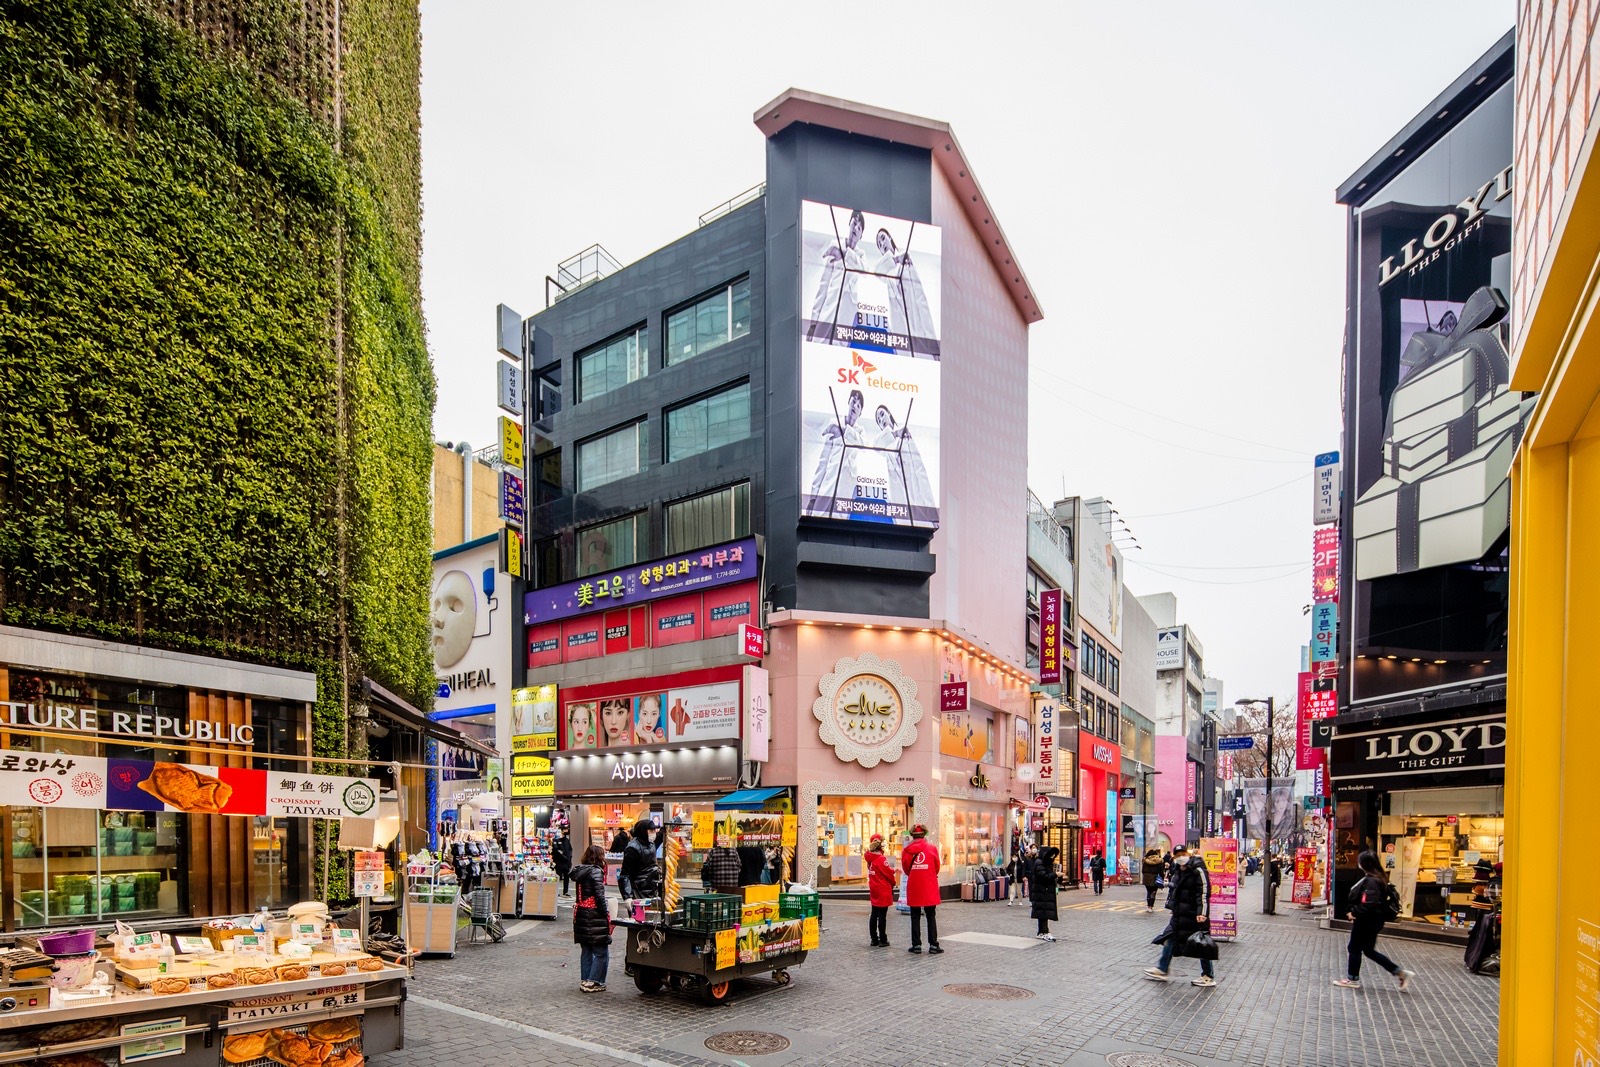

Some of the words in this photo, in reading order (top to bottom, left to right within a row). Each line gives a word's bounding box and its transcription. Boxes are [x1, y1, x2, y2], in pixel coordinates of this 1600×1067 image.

[1408, 248, 1441, 277] THE
[1444, 216, 1484, 251] GIFT
[857, 312, 888, 328] BLUE
[838, 368, 860, 385] SK
[867, 376, 919, 393] telecom
[856, 485, 888, 500] BLUE
[1315, 550, 1336, 566] 2F
[1316, 608, 1332, 658] 푸른약국
[943, 688, 965, 698] キラ星
[844, 692, 892, 716] clue
[0, 701, 98, 731] TURE
[112, 712, 254, 744] REPUBLIC
[1366, 722, 1507, 760] LLOYD
[1092, 744, 1112, 764] MISSHA
[1398, 758, 1427, 769] THE
[1430, 755, 1466, 766] GIFT
[0, 755, 76, 776] 로와상
[516, 760, 548, 770] イチロカバン
[514, 780, 530, 788] FOOT
[536, 779, 554, 787] BODY
[270, 798, 322, 806] CROISSANT
[282, 805, 342, 816] TAIYAKI
[1204, 850, 1225, 872] 足
[231, 994, 294, 1008] CROISSANT
[233, 1002, 310, 1020] TAIYAKI
